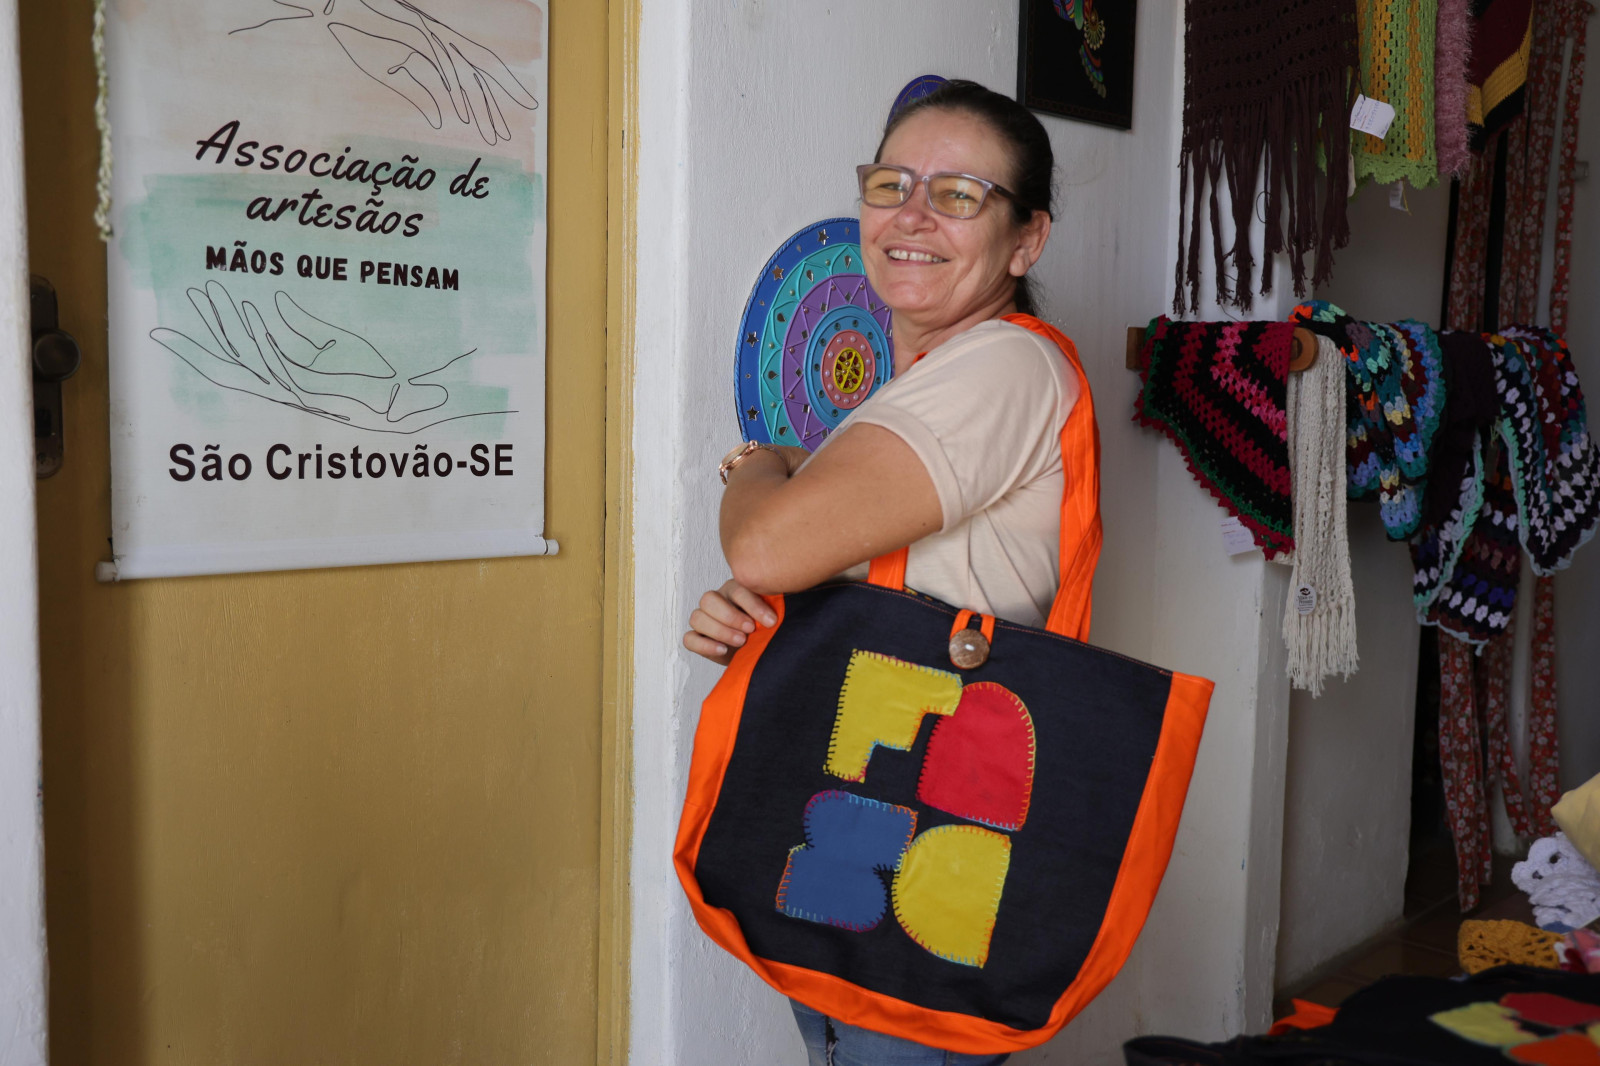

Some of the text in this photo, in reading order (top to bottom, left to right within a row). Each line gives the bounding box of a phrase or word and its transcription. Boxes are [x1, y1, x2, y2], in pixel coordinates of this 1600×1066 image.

[196, 120, 490, 199] Associação de
[247, 188, 424, 237] artesãos
[206, 240, 459, 291] MÃOS QUE PENSAM
[169, 444, 514, 481] São Cristovão-SE
